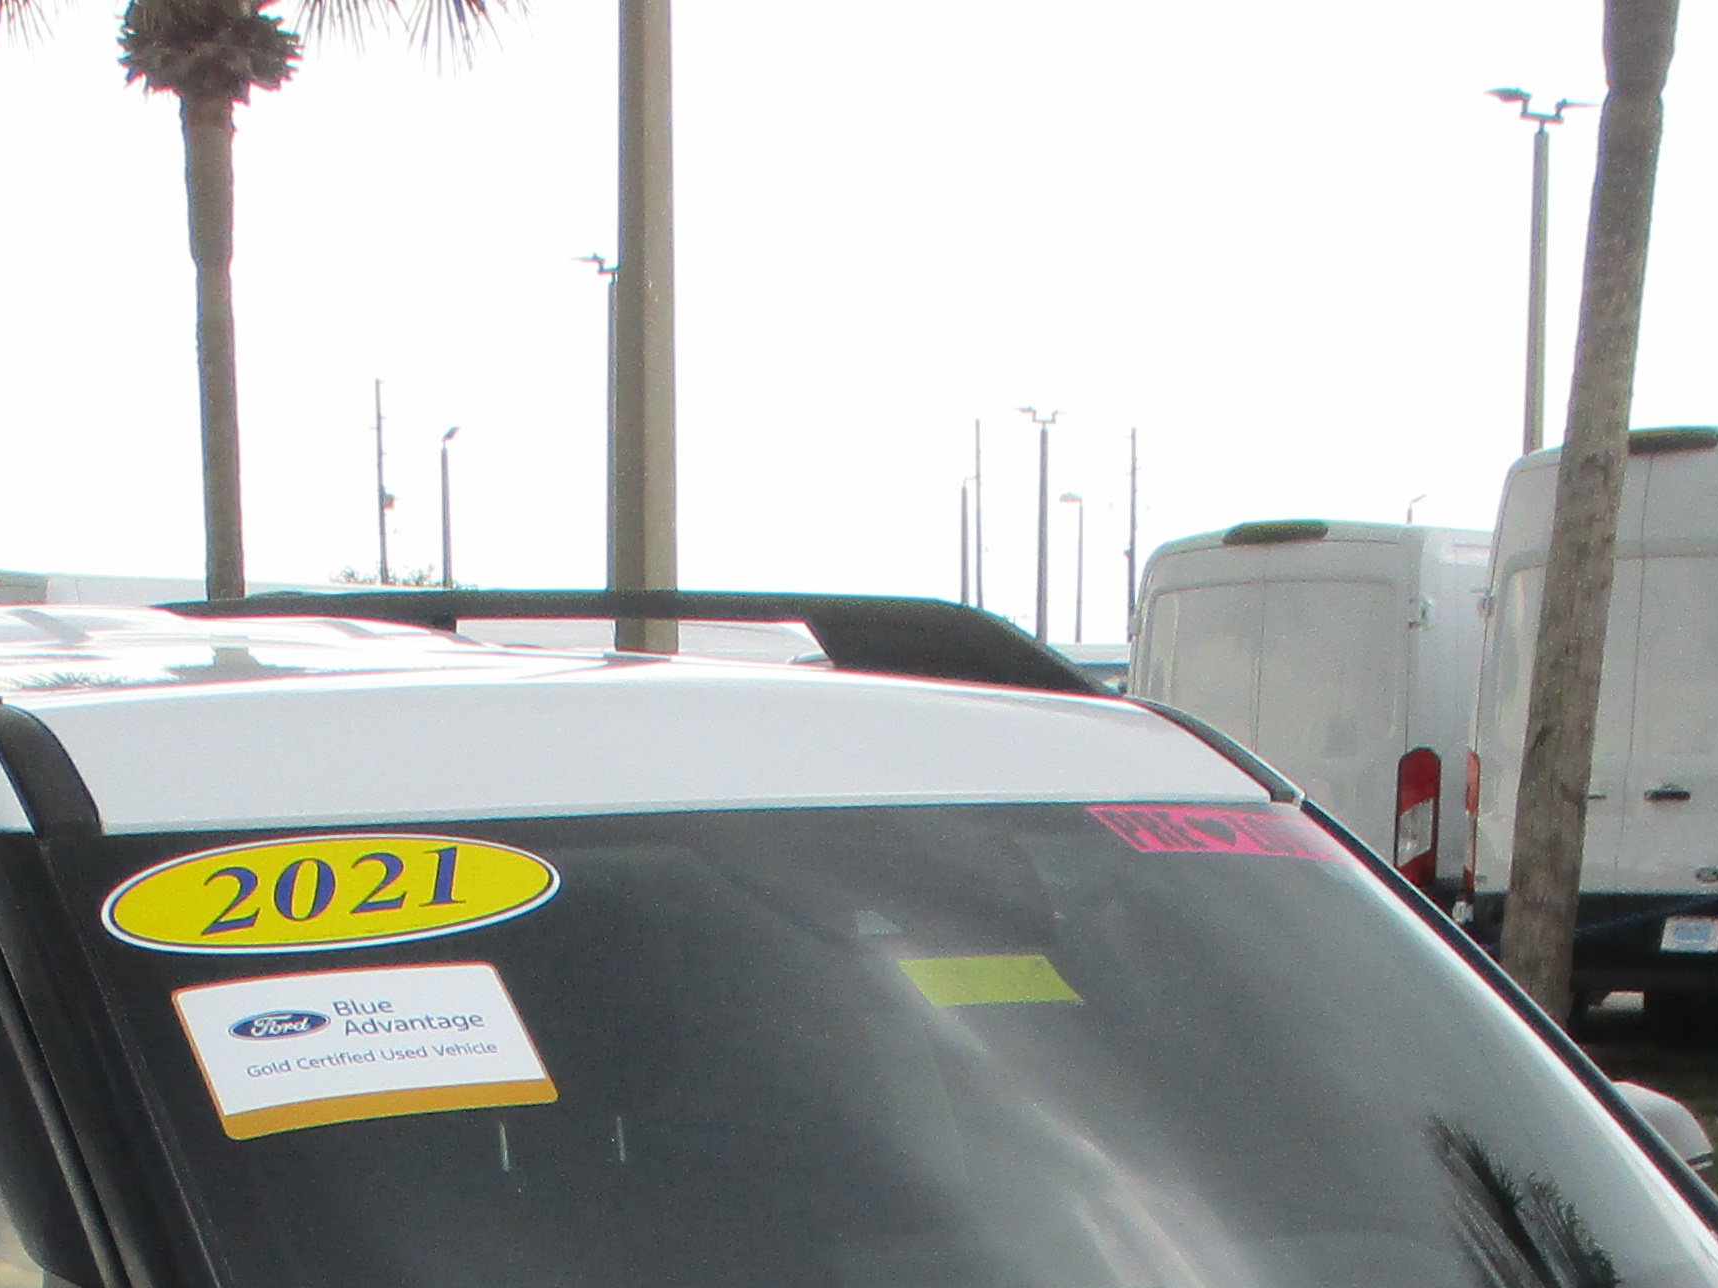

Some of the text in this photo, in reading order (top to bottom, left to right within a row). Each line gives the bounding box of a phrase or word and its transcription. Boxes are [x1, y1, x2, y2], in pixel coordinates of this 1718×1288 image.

[201, 845, 466, 936] 2021
[333, 999, 394, 1017] Blue
[250, 1012, 312, 1038] Ford
[344, 1012, 486, 1037] Advantage
[246, 1041, 499, 1079] Gold Certified Used Vehicle
